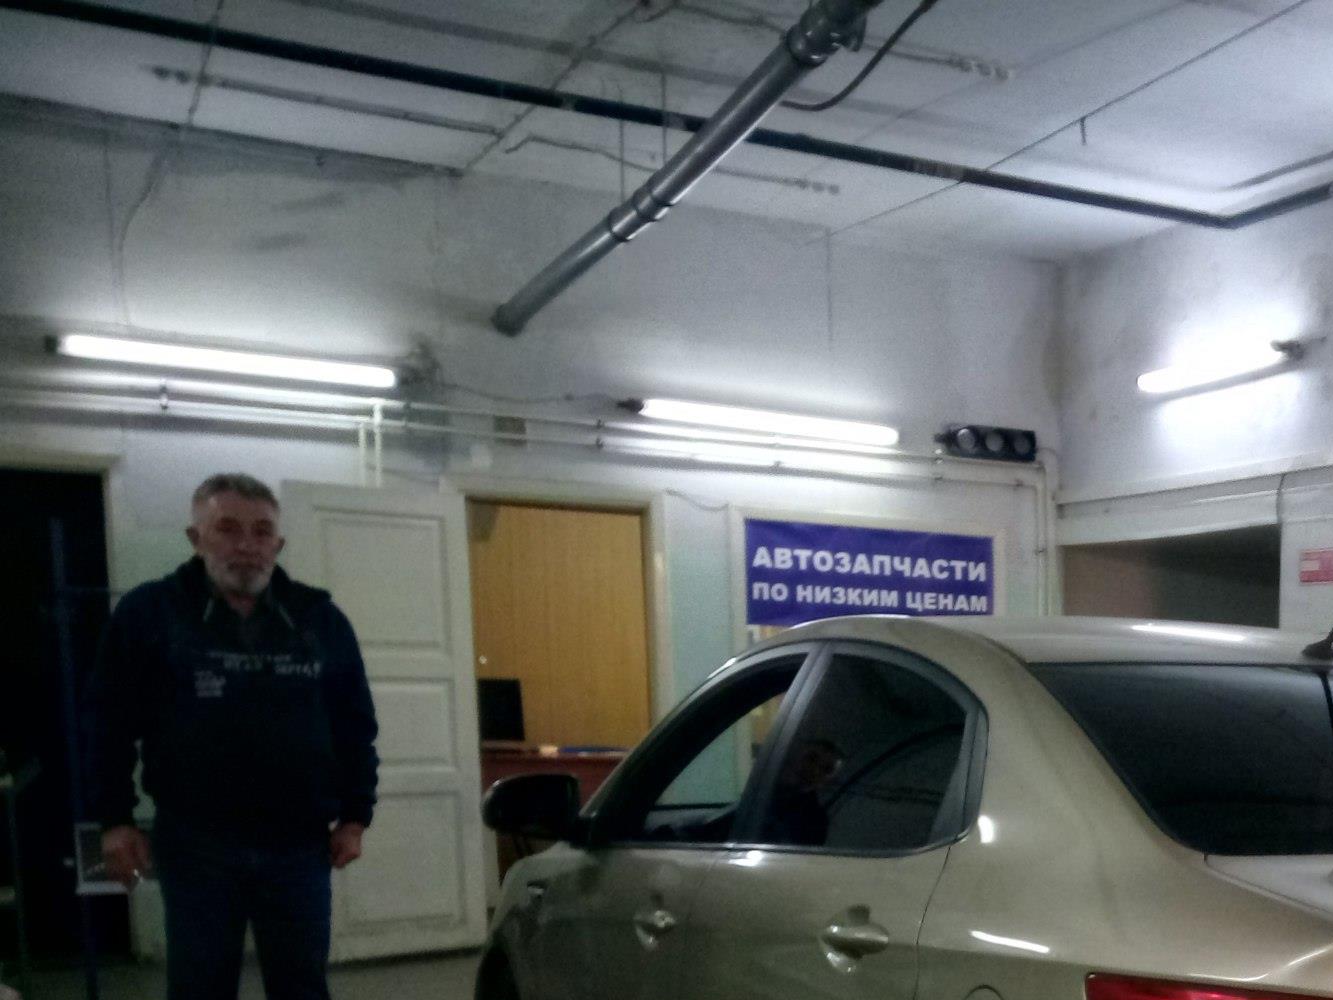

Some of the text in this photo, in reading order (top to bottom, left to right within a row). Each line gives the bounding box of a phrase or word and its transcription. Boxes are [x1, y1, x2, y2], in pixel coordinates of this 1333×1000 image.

[752, 546, 987, 582] АВТОЗАПЧАСТИ
[752, 581, 988, 612] ПО НИЗКИМ ЦЕНАМ
